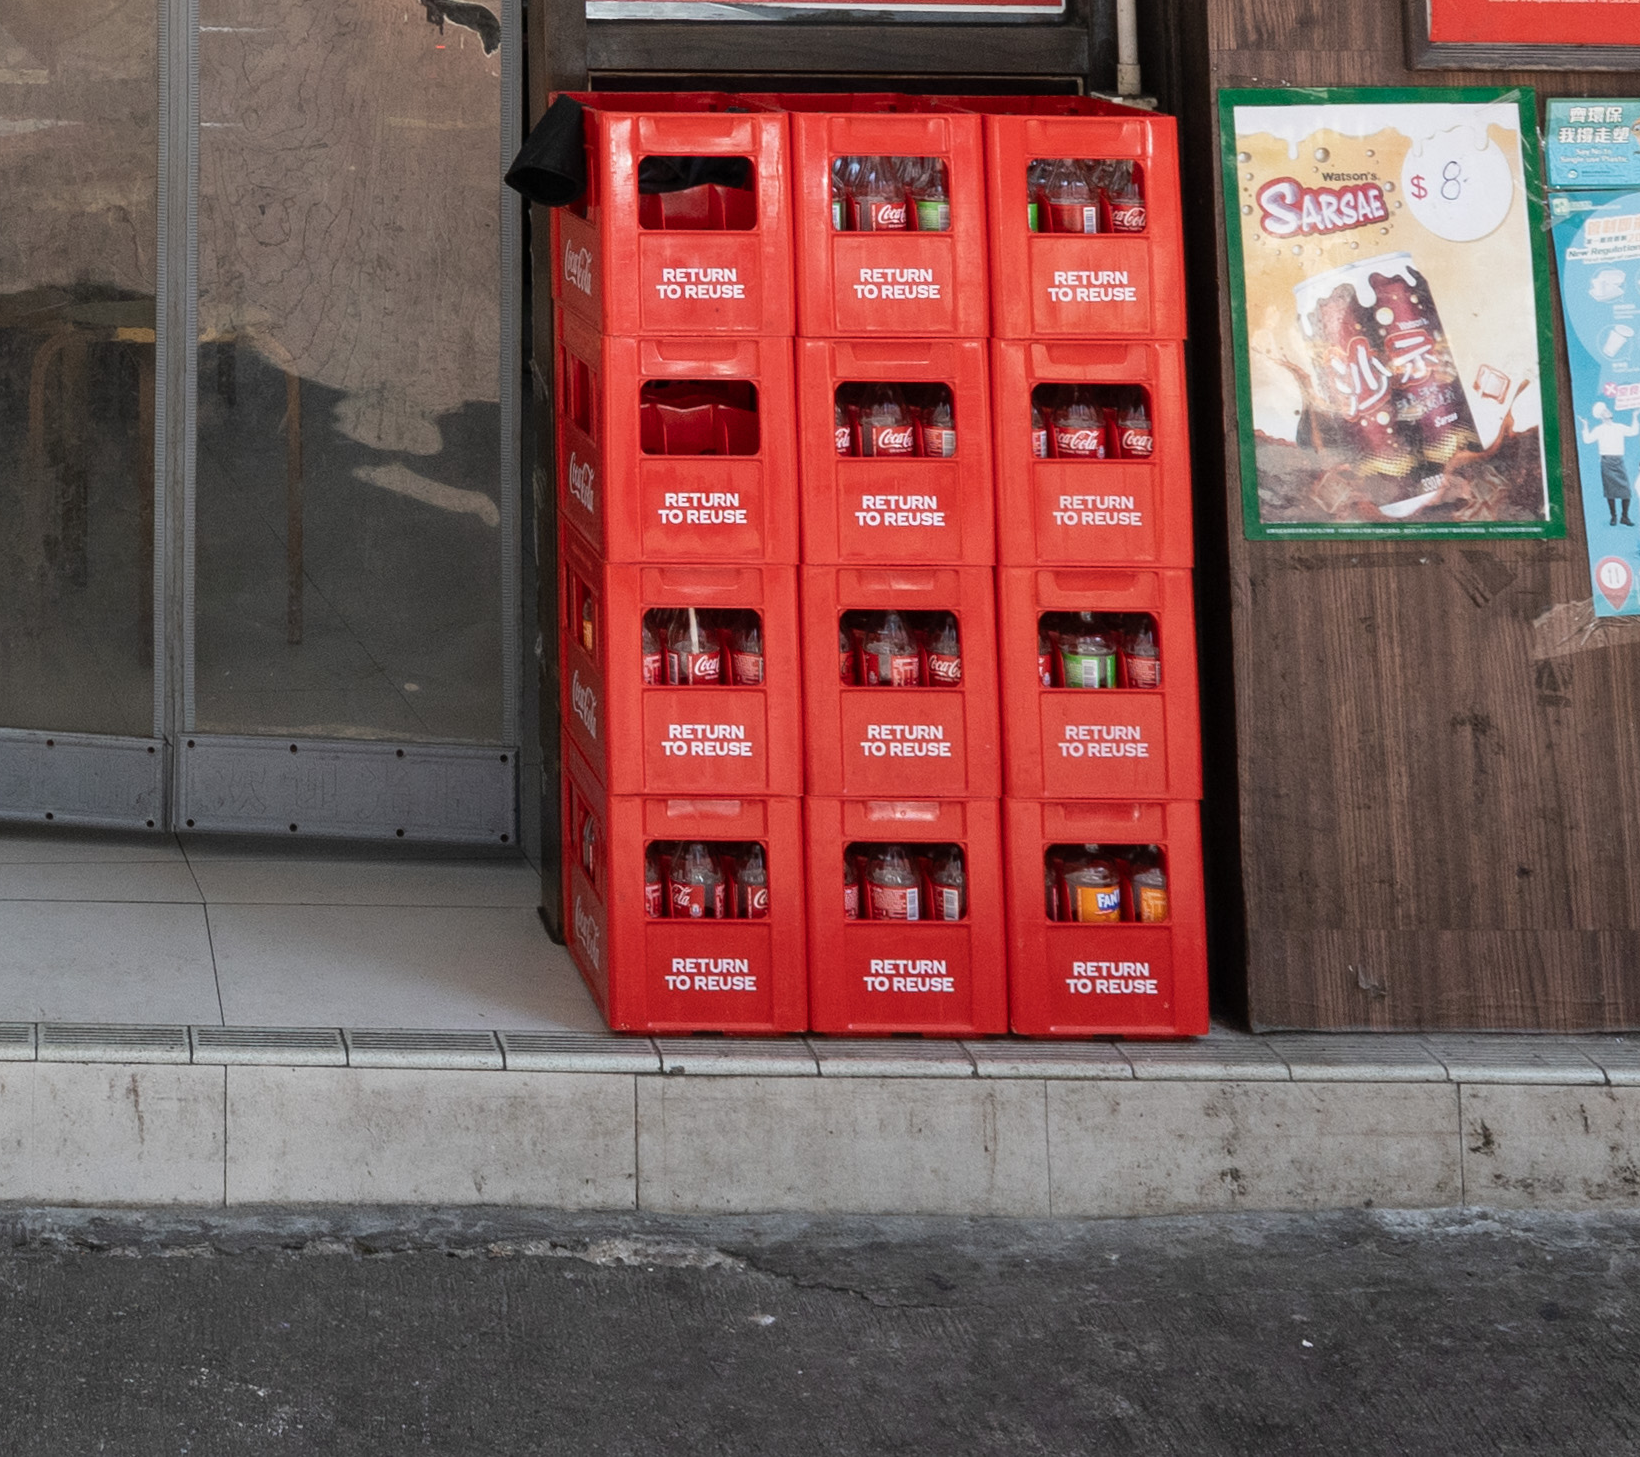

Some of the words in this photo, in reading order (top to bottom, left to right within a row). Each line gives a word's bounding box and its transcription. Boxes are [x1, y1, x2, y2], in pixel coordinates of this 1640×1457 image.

[1569, 106, 1624, 123] 齊環保
[1258, 181, 1385, 236] SARSAE
[1568, 248, 1589, 258] New
[663, 267, 738, 283] RETURN
[656, 284, 683, 299] TO
[686, 284, 745, 300] REUSE
[1058, 494, 1135, 511] RETURN
[1052, 511, 1080, 527] TO
[1082, 511, 1143, 527] REUSE
[870, 958, 947, 976] RETURN
[863, 976, 890, 992] TO
[893, 975, 955, 993] REUSE
